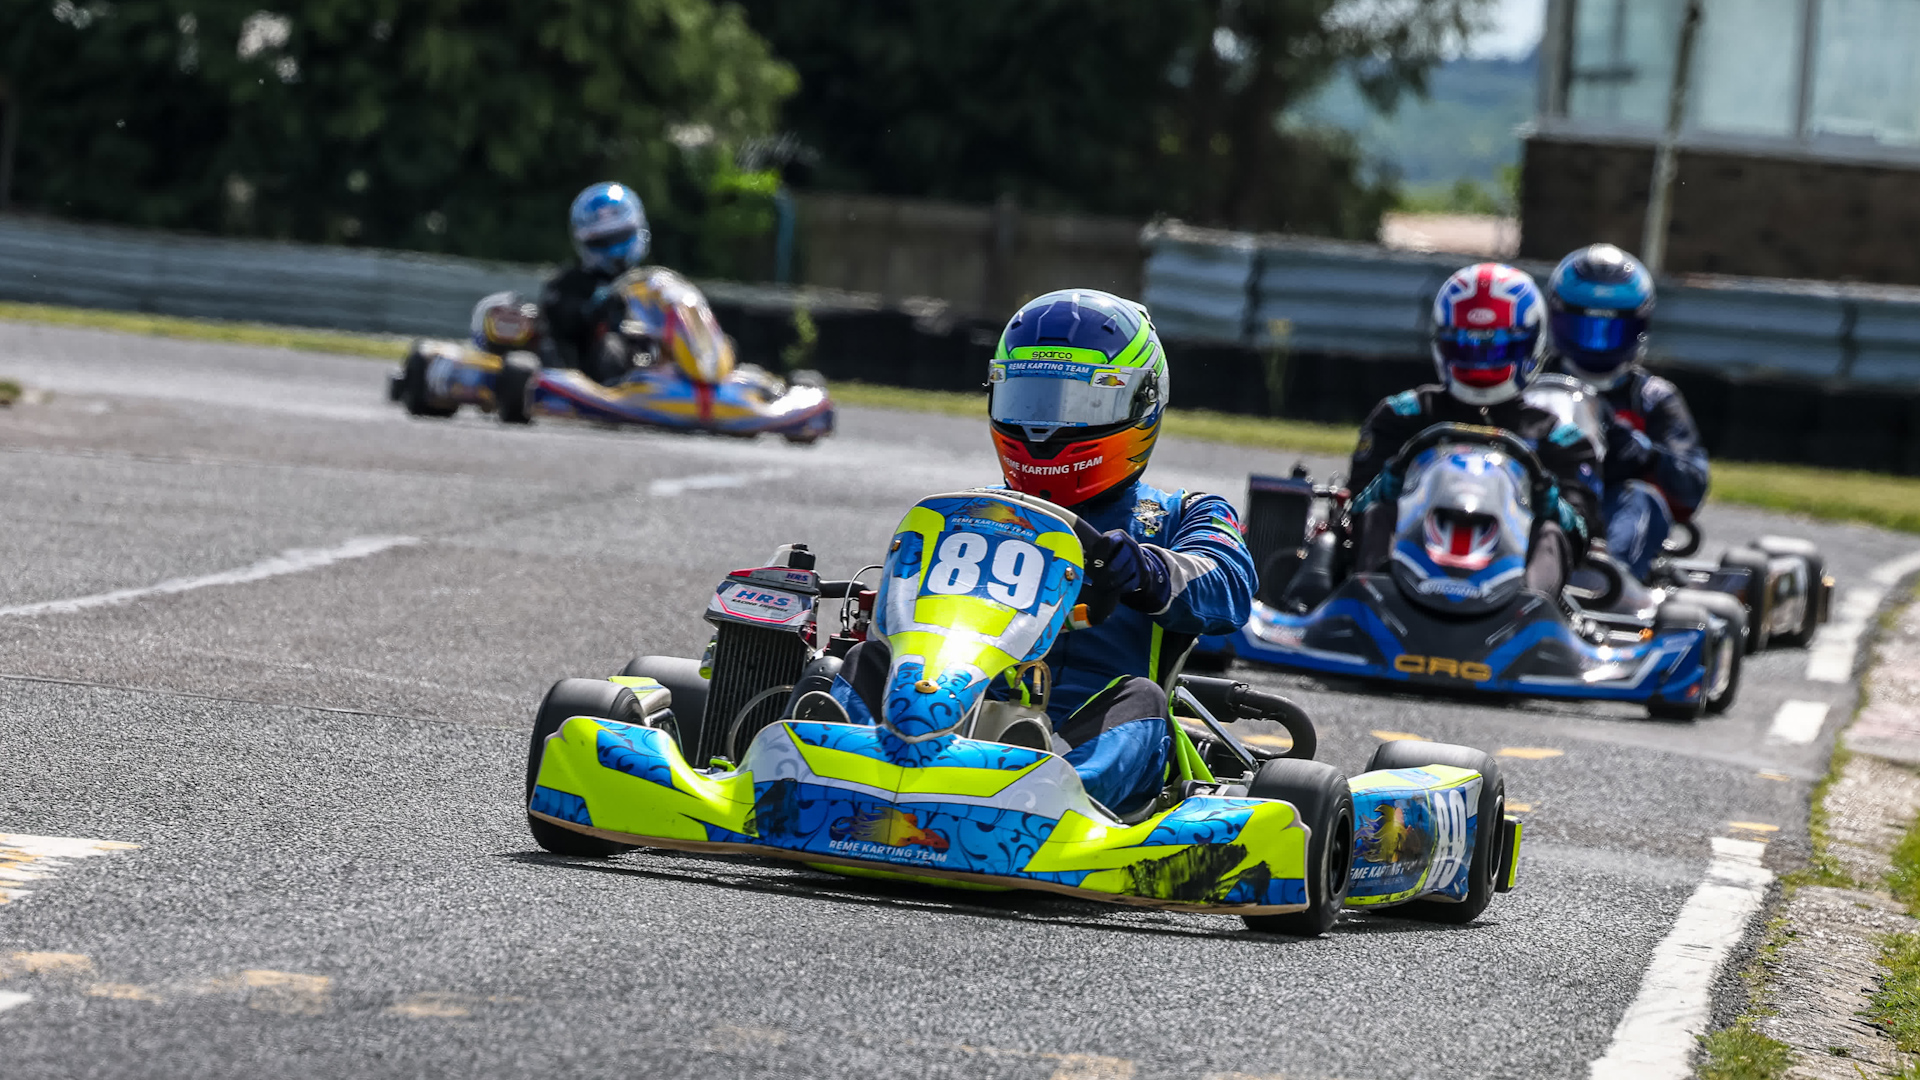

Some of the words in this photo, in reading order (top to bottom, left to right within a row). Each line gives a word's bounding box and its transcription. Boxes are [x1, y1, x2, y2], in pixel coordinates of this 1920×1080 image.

[1032, 350, 1073, 361] sparco
[1008, 363, 1027, 371] REME
[1027, 362, 1064, 371] KARTING
[1065, 364, 1090, 374] TEAM
[1021, 464, 1070, 475] KARTING
[1073, 456, 1103, 471] TEAM
[974, 519, 1010, 530] KARTING
[1012, 526, 1034, 538] TEAM
[786, 572, 809, 581] HRS
[927, 532, 1045, 610] 89
[734, 589, 792, 607] HRS
[829, 840, 860, 851] REME
[861, 843, 913, 858] KARTING
[916, 850, 948, 863] TEAM
[1350, 866, 1370, 880] EME
